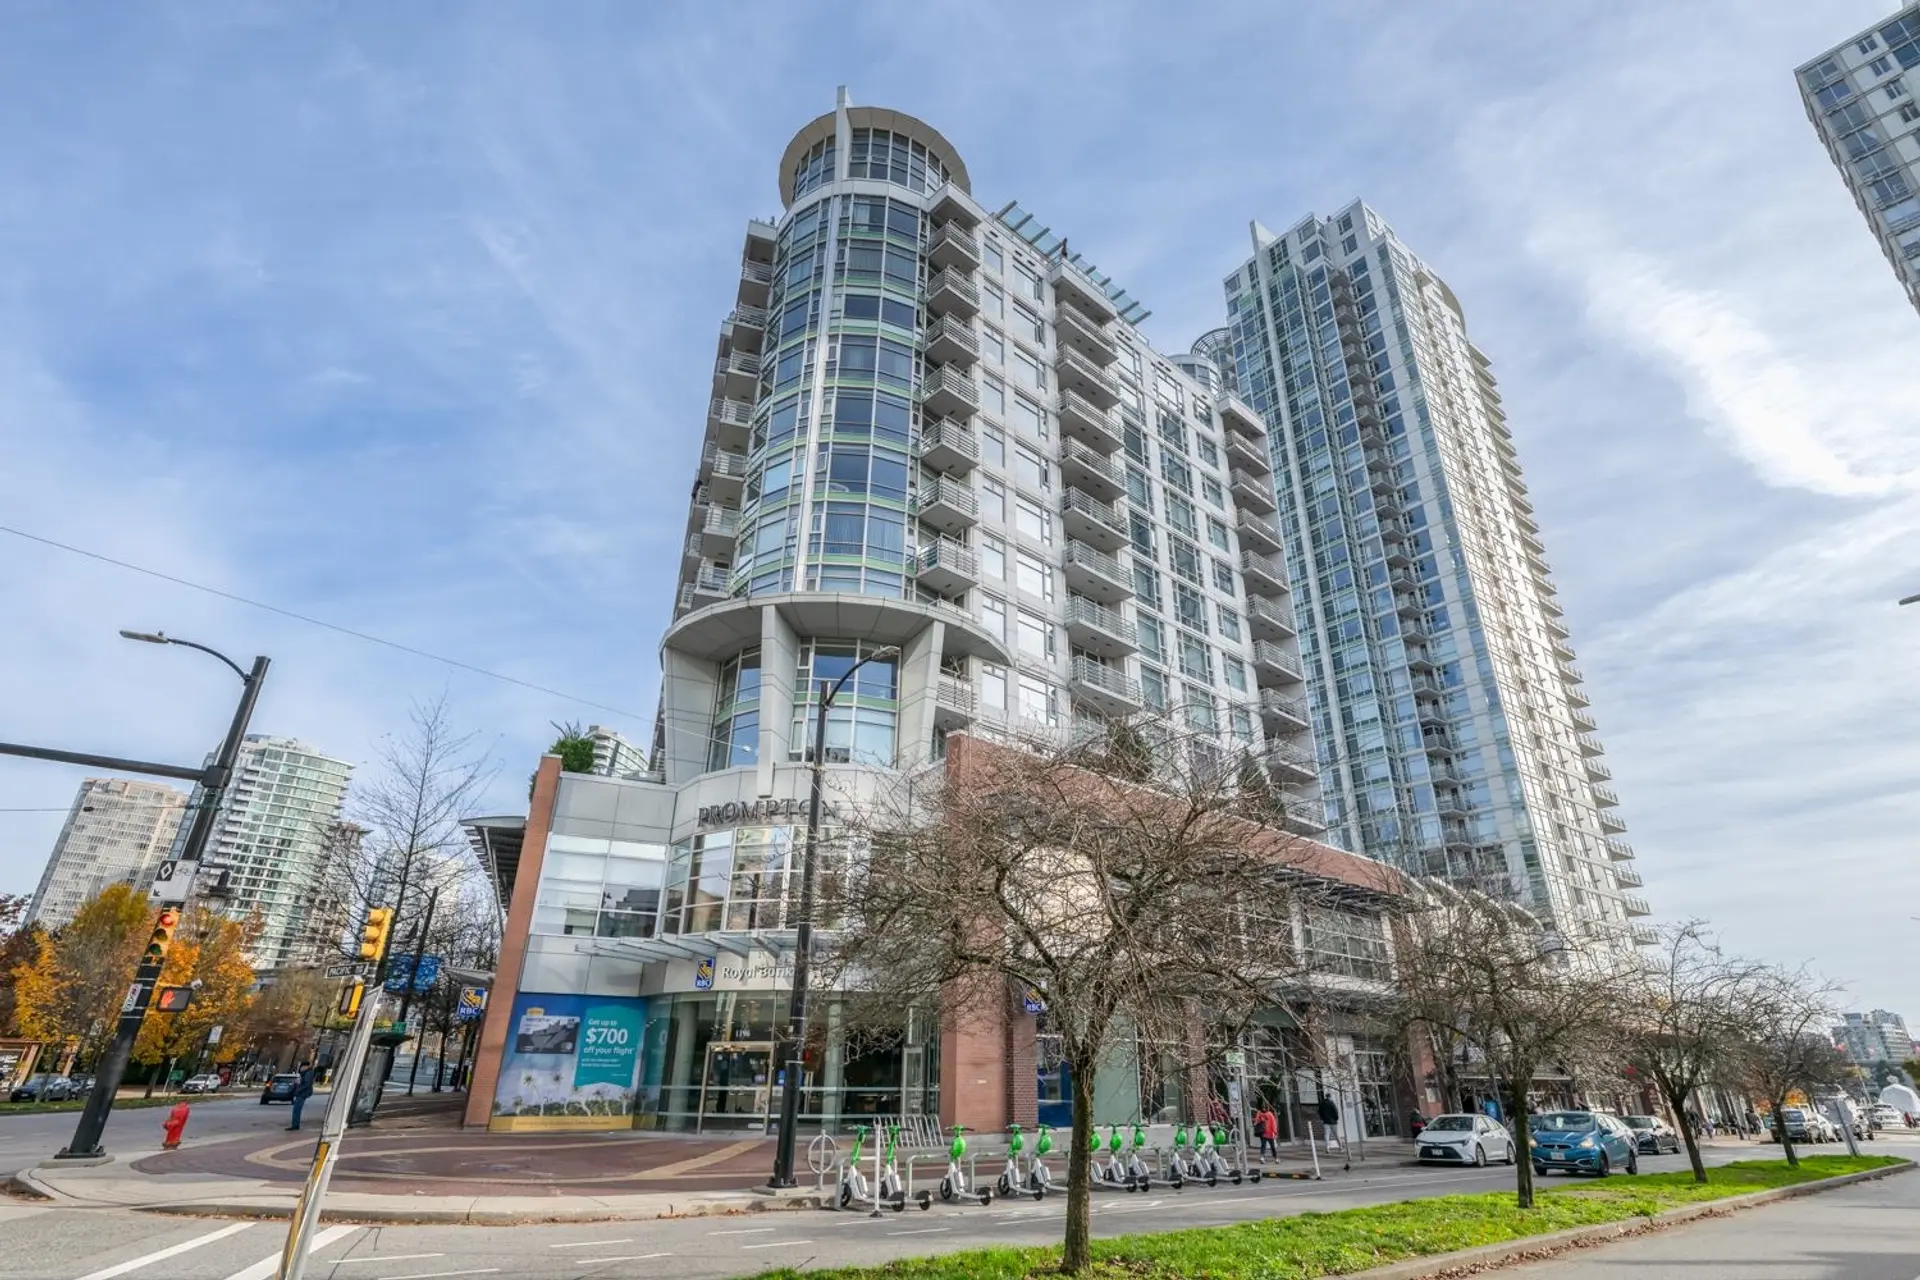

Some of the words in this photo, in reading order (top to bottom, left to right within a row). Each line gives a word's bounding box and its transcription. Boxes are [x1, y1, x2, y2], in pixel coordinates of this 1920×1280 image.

[722, 966, 757, 982] Royal
[760, 967, 796, 978] Bank
[696, 979, 712, 988] RBC
[459, 1006, 480, 1016] RBC
[585, 1027, 628, 1045] $700
[583, 1046, 595, 1054] off
[595, 1047, 612, 1056] your
